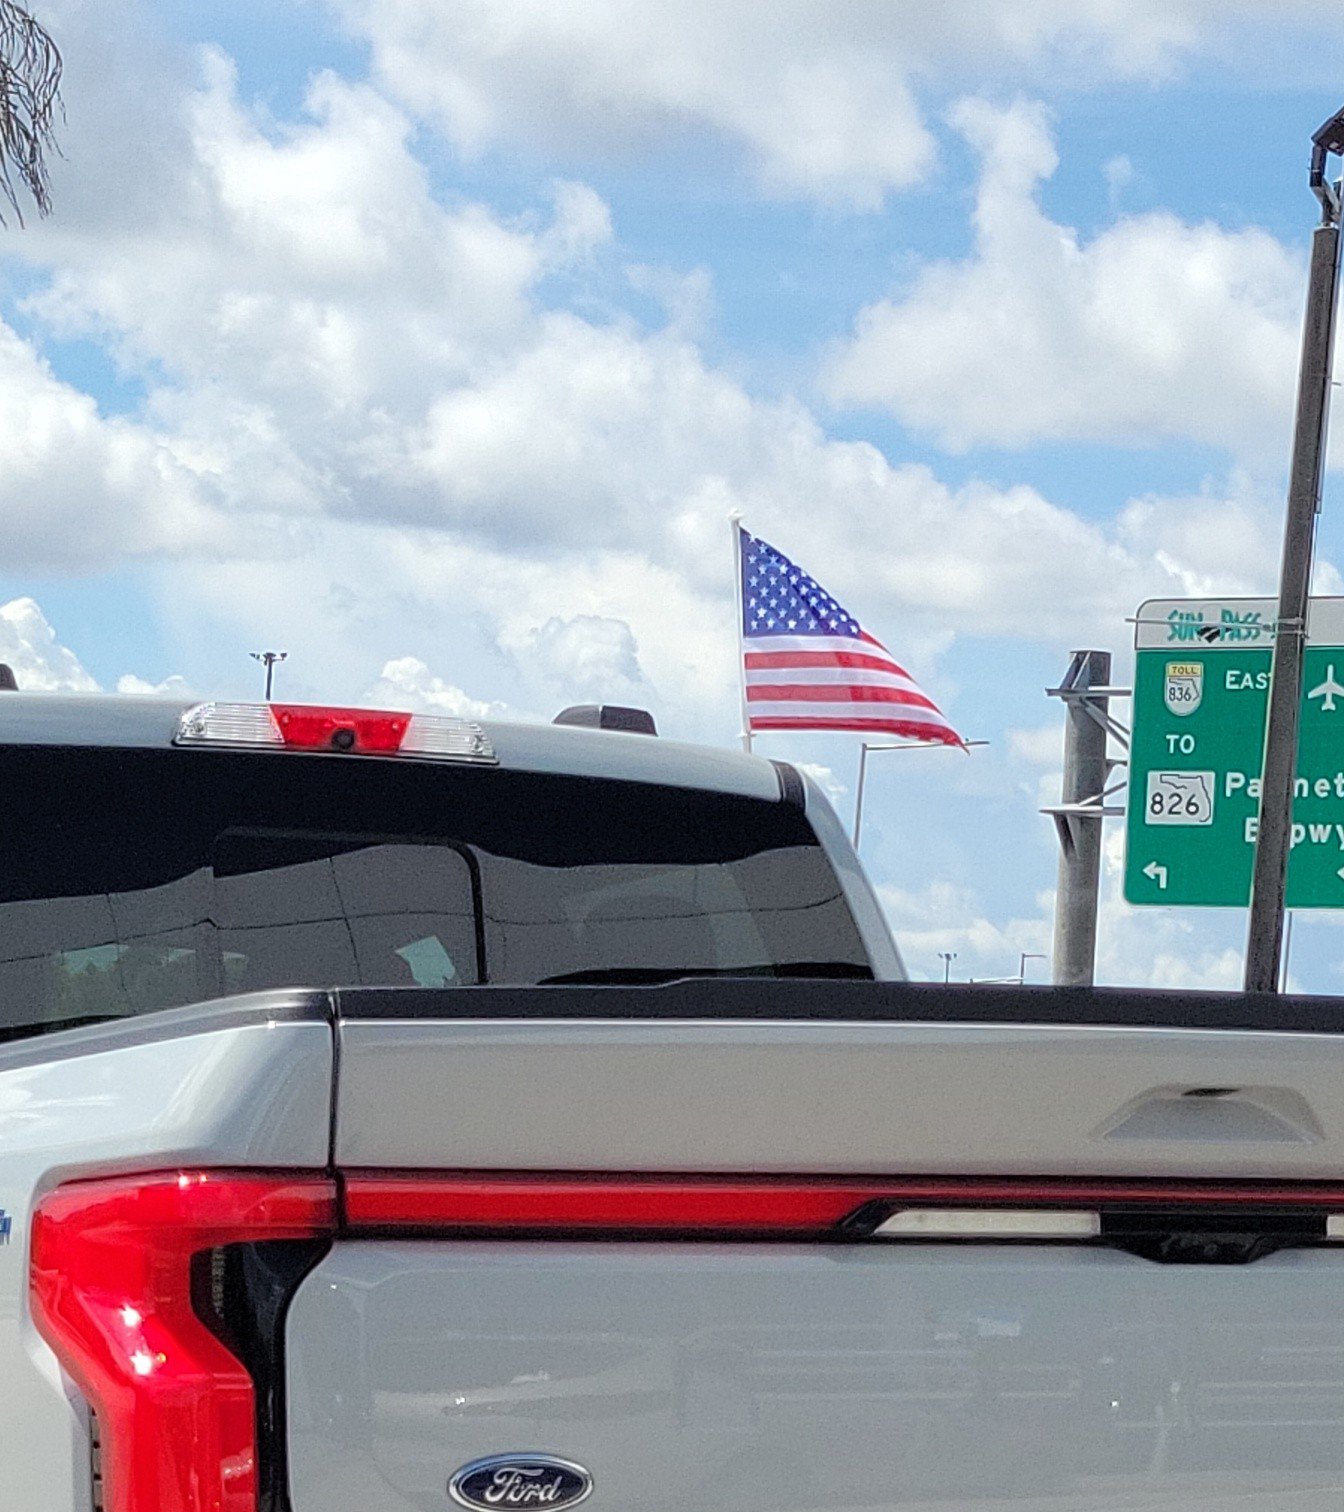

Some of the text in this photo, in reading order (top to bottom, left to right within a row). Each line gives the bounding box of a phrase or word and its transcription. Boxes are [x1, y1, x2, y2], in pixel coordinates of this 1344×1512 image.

[1172, 665, 1198, 675] TOLL
[1225, 669, 1272, 690] EAS
[1168, 686, 1192, 702] 836
[1166, 734, 1195, 754] TO
[1150, 792, 1200, 816] 826
[484, 1467, 562, 1503] Ford
